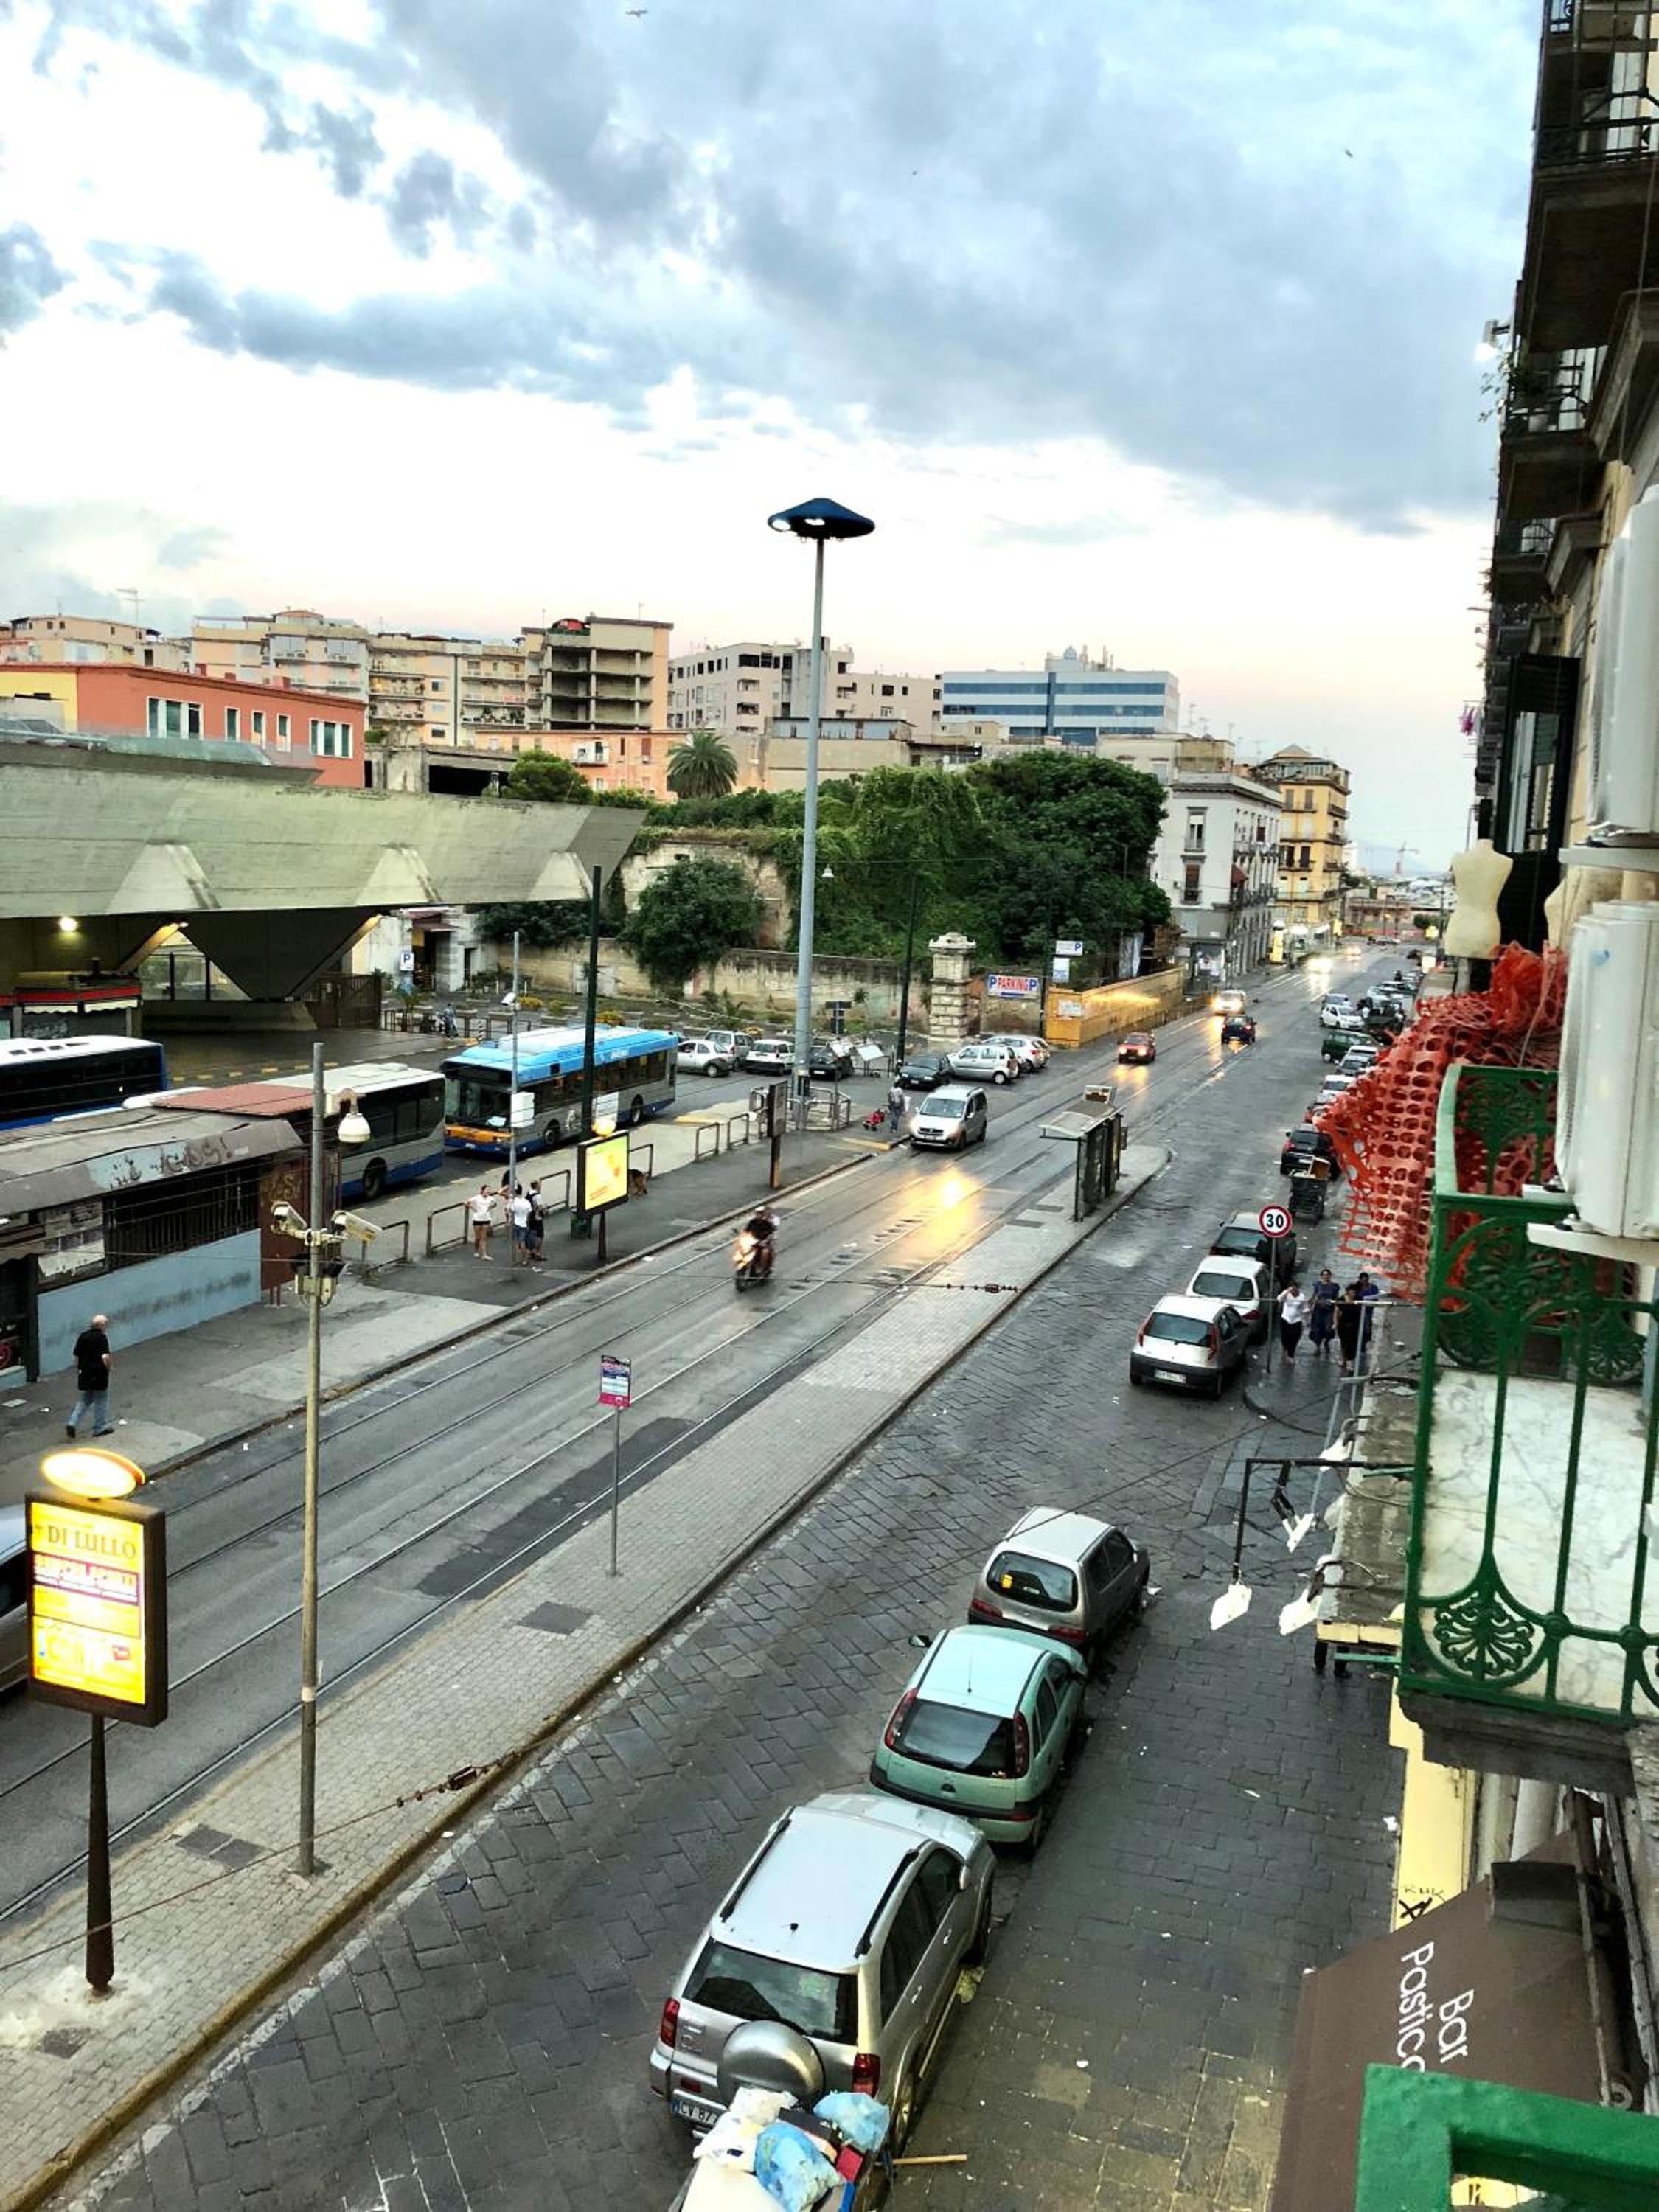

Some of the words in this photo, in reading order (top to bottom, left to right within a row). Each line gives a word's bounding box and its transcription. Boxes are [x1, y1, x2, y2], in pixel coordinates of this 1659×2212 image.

[1074, 943, 1082, 951] P
[403, 953, 411, 963] P
[989, 975, 998, 989] P
[998, 977, 1029, 992] PARKING
[1029, 979, 1037, 992] P
[1266, 1213, 1284, 1228] 30
[47, 1526, 67, 1546] DI
[75, 1531, 136, 1559] LULLO
[1439, 1989, 1475, 2064] Bar
